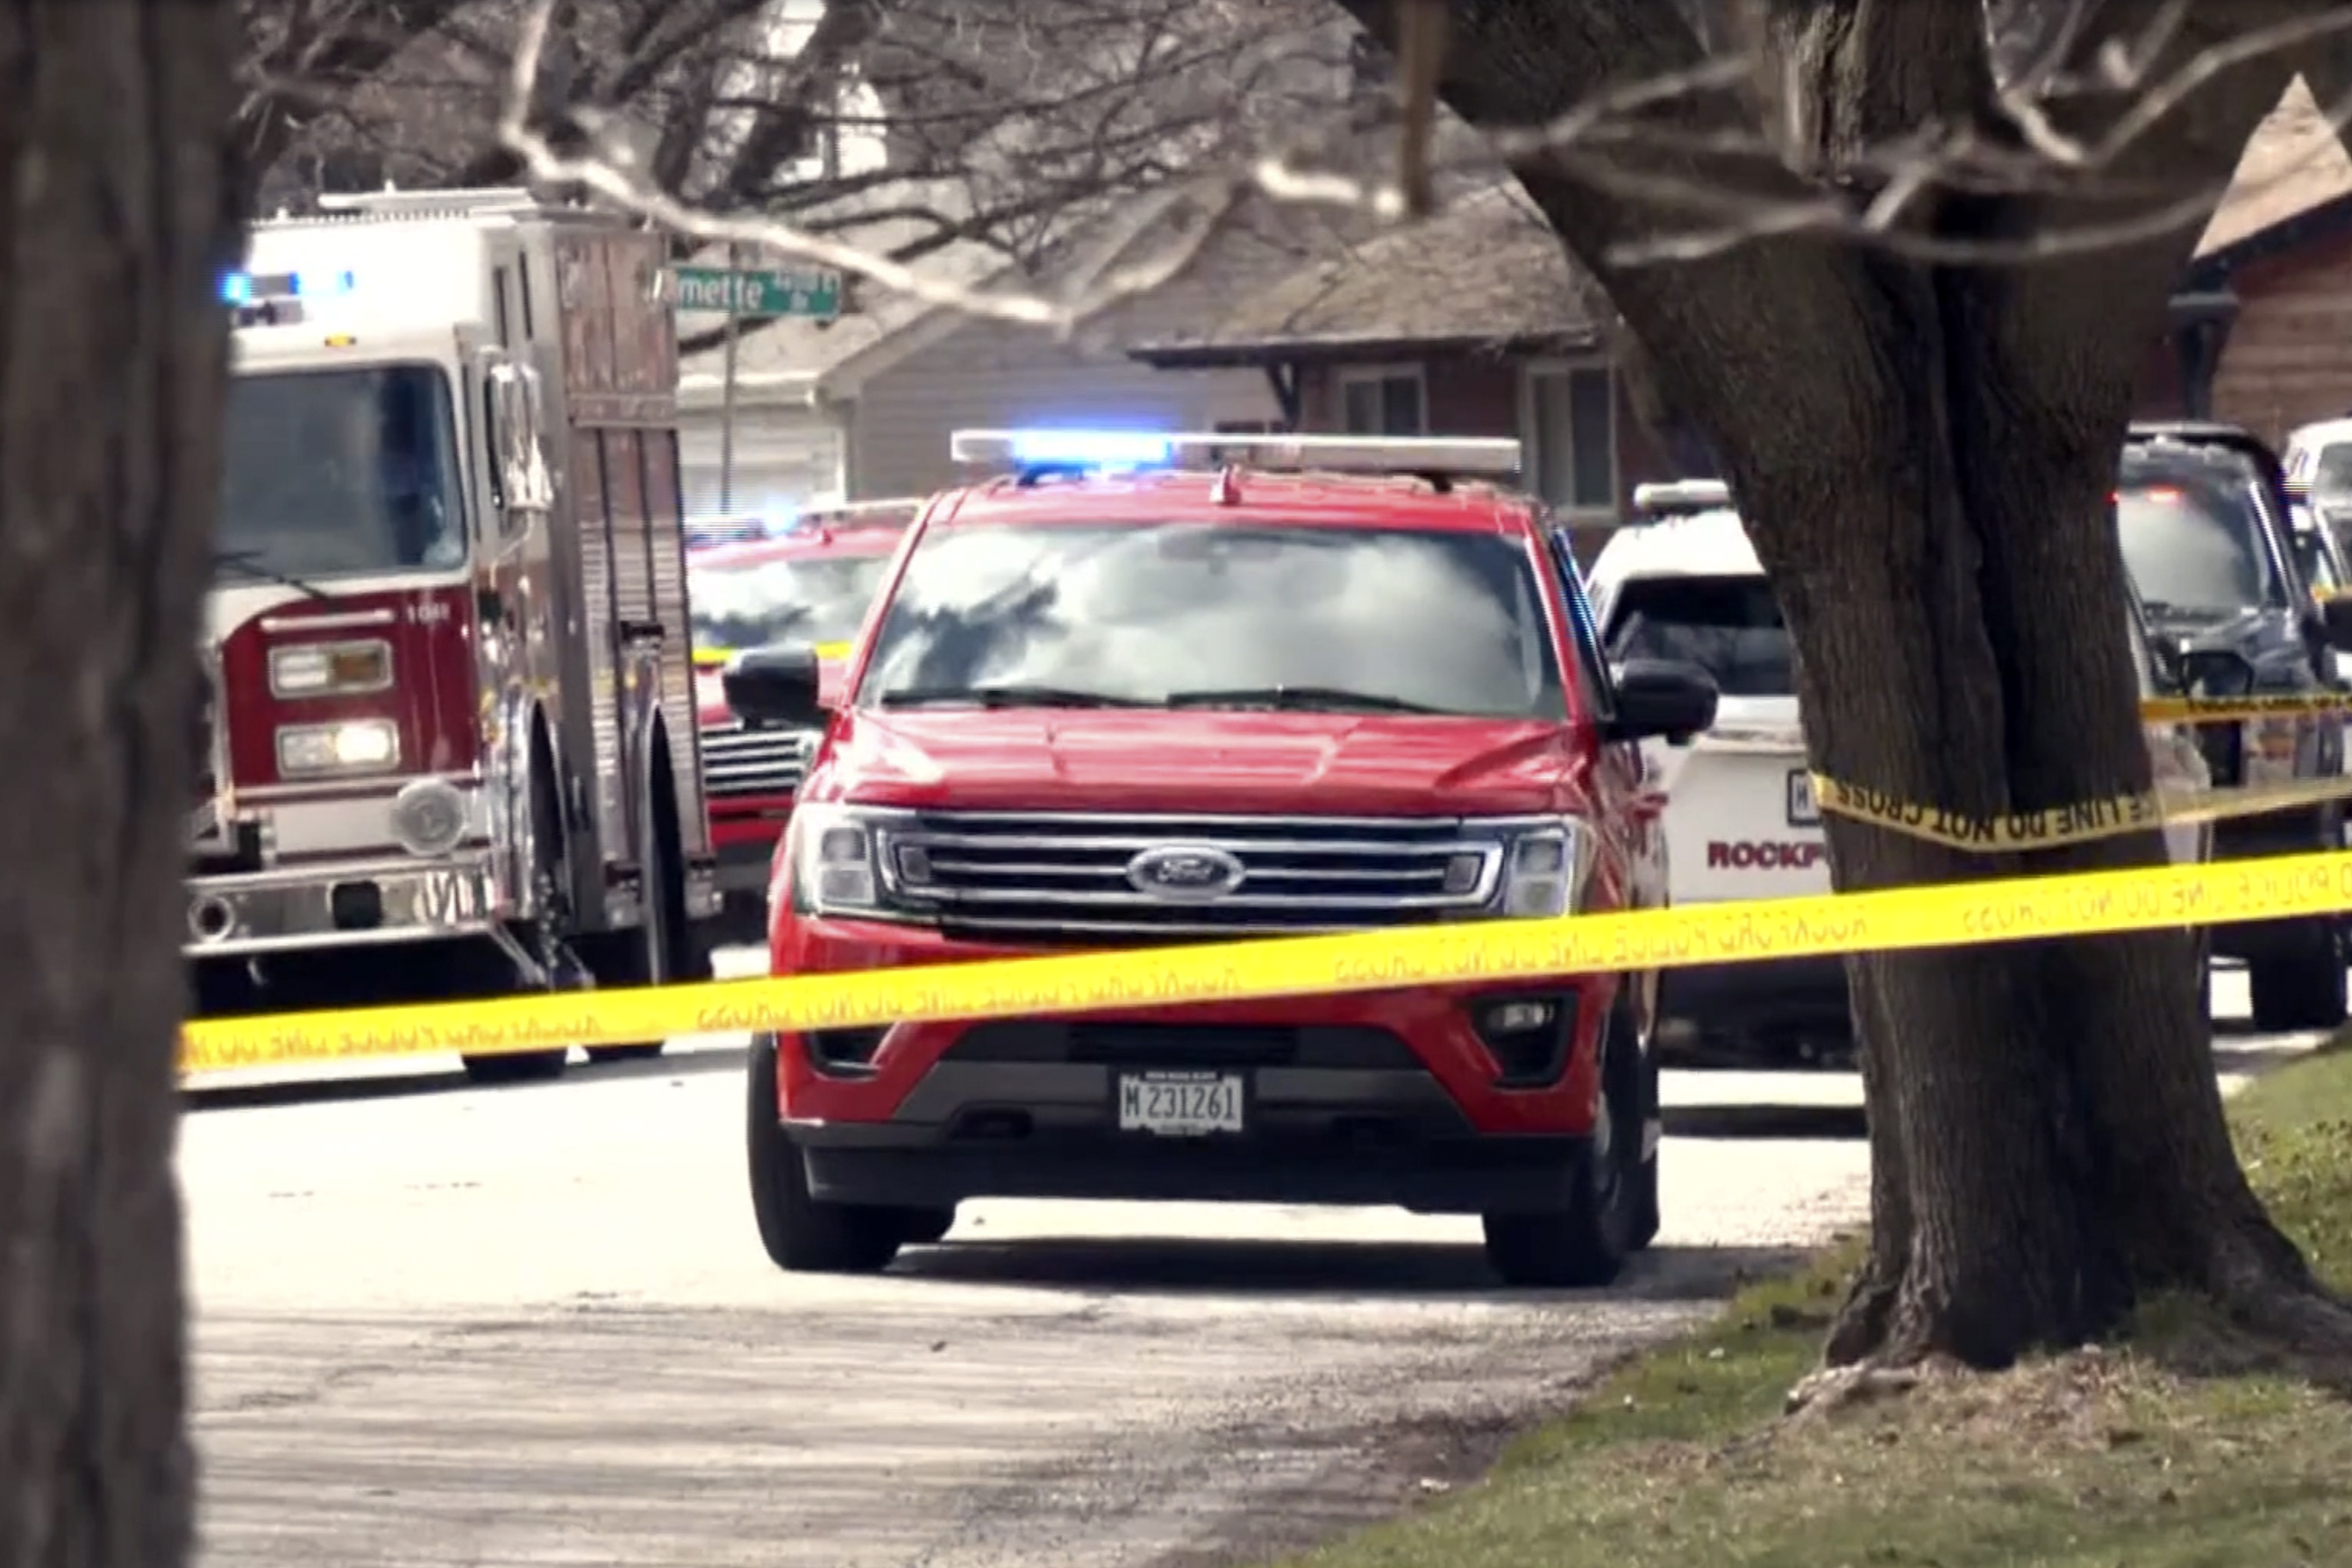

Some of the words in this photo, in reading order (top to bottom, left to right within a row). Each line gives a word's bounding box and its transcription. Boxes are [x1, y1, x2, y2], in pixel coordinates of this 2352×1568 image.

[1928, 808, 1996, 841] NOT
[2006, 814, 2047, 839] DO
[2056, 798, 2121, 834] LINE
[1147, 1087, 1236, 1120] 231261
